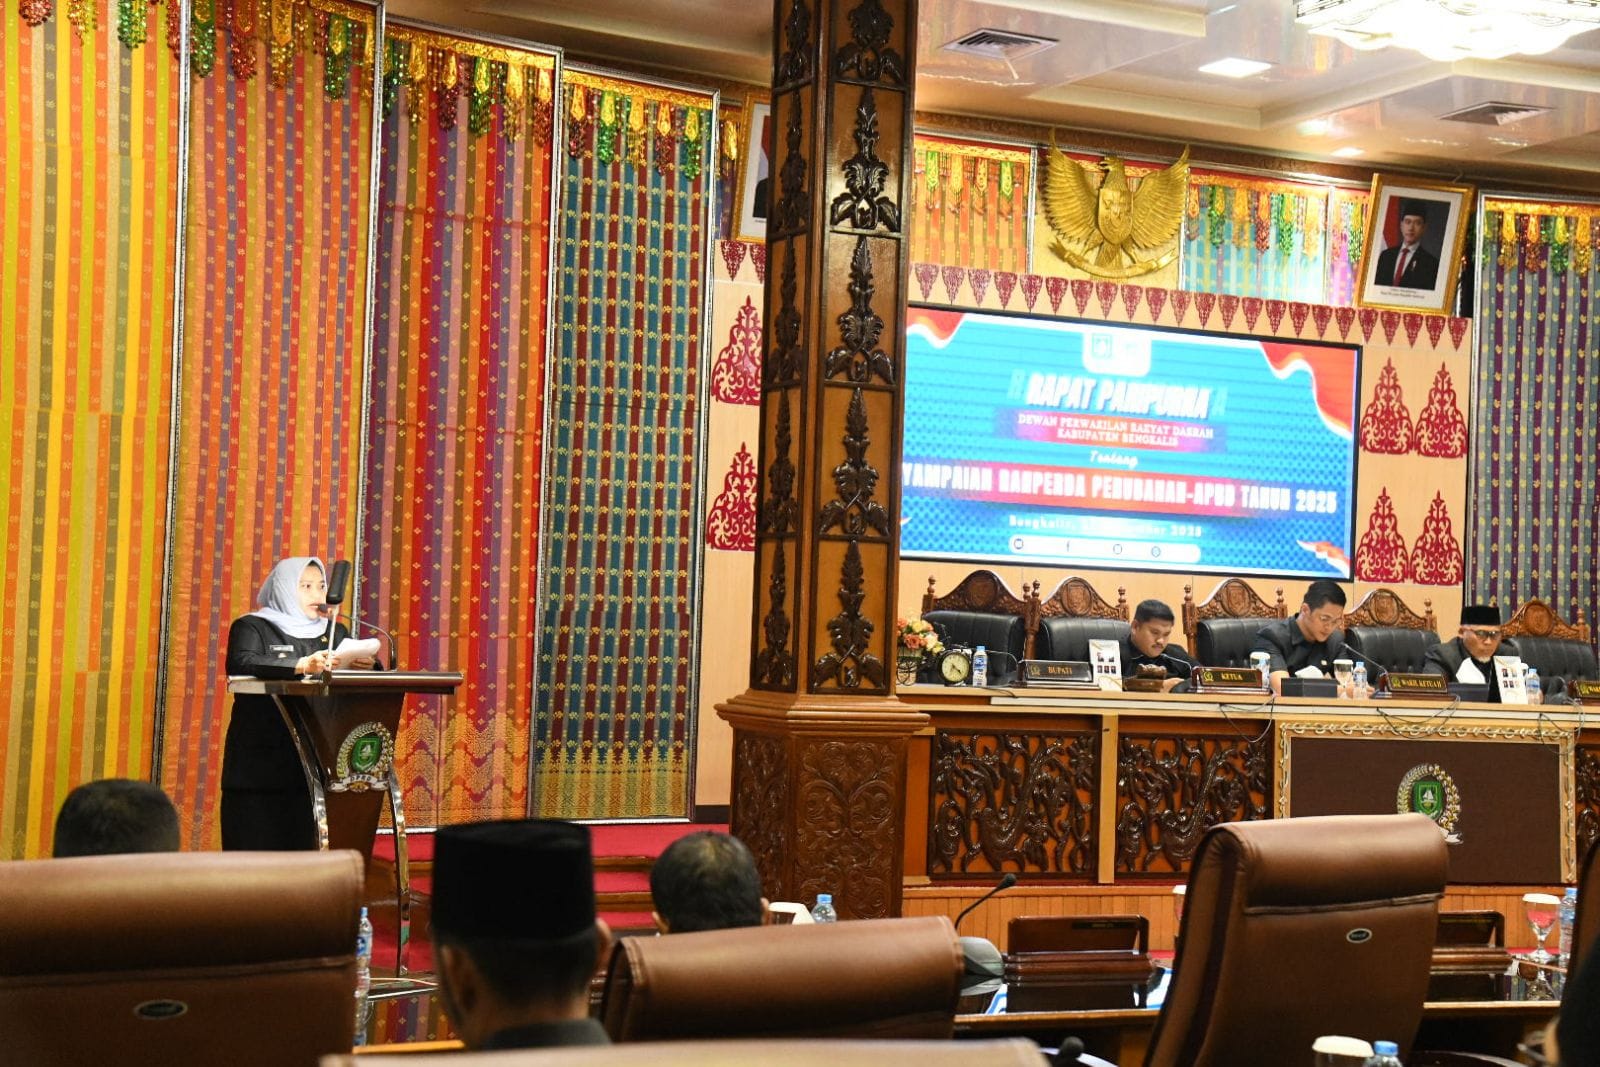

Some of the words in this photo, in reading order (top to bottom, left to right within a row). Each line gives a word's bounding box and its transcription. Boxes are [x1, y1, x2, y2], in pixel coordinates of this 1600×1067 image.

[1026, 373, 1096, 409] RAPAT
[1018, 414, 1057, 426] DEWAN
[1060, 417, 1128, 432] PERWAKILAN
[1130, 422, 1171, 436] RAKYAT
[1172, 425, 1214, 439] DAERAH
[1057, 428, 1120, 442] KABUPATEN
[1122, 433, 1178, 447] BENGKALIS
[1089, 450, 1138, 469] Tentang
[1240, 485, 1291, 511] TAHUN
[1295, 489, 1337, 514] 2025
[1048, 666, 1073, 675] BUPATI
[1221, 672, 1243, 681] KETUA
[1419, 680, 1437, 688] KETUA
